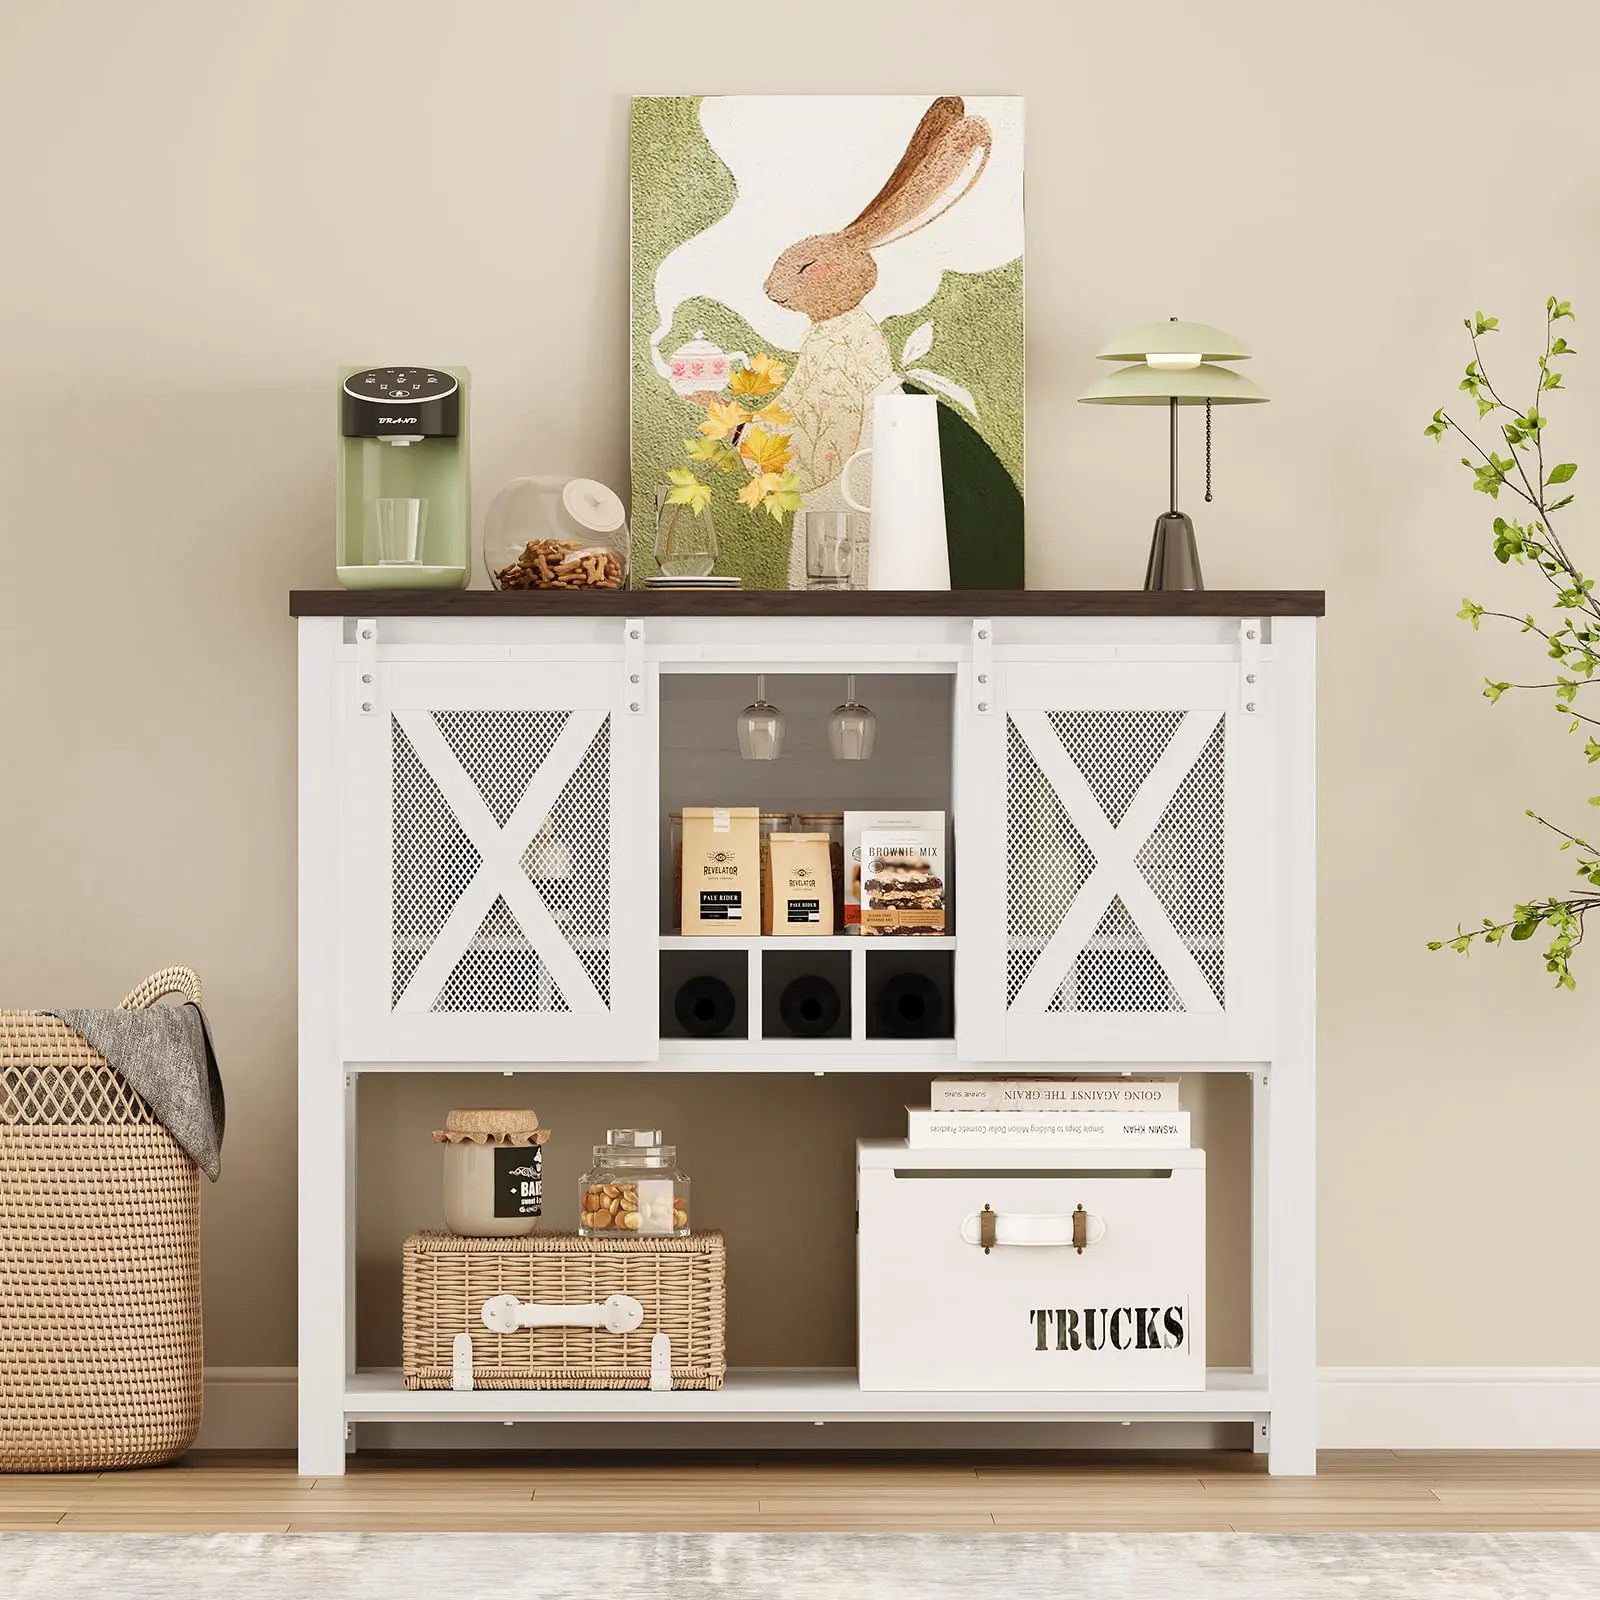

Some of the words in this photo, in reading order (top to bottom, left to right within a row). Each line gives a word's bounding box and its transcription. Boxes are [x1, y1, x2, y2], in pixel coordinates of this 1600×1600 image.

[869, 847, 914, 857] BROWNIE
[920, 847, 938, 857] MIX
[703, 866, 738, 876] REVELATOR
[789, 879, 816, 888] REVELATOR
[1004, 1090, 1041, 1101] GRAIN
[1044, 1090, 1067, 1101] THE
[1070, 1090, 1121, 1101] AGAINST
[1124, 1090, 1162, 1101] GOING
[929, 1125, 957, 1134] Practices
[958, 1125, 987, 1134] Cosmetic
[988, 1125, 1007, 1134] Dollar
[1008, 1125, 1030, 1134] Million
[1030, 1123, 1056, 1134] Building
[1057, 1125, 1064, 1133] to
[1065, 1124, 1082, 1134] Steps
[1083, 1124, 1104, 1134] Simple
[1123, 1125, 1146, 1135] KHAN
[1148, 1125, 1179, 1135] YASMIN
[1030, 1306, 1184, 1351] TRUCKS
